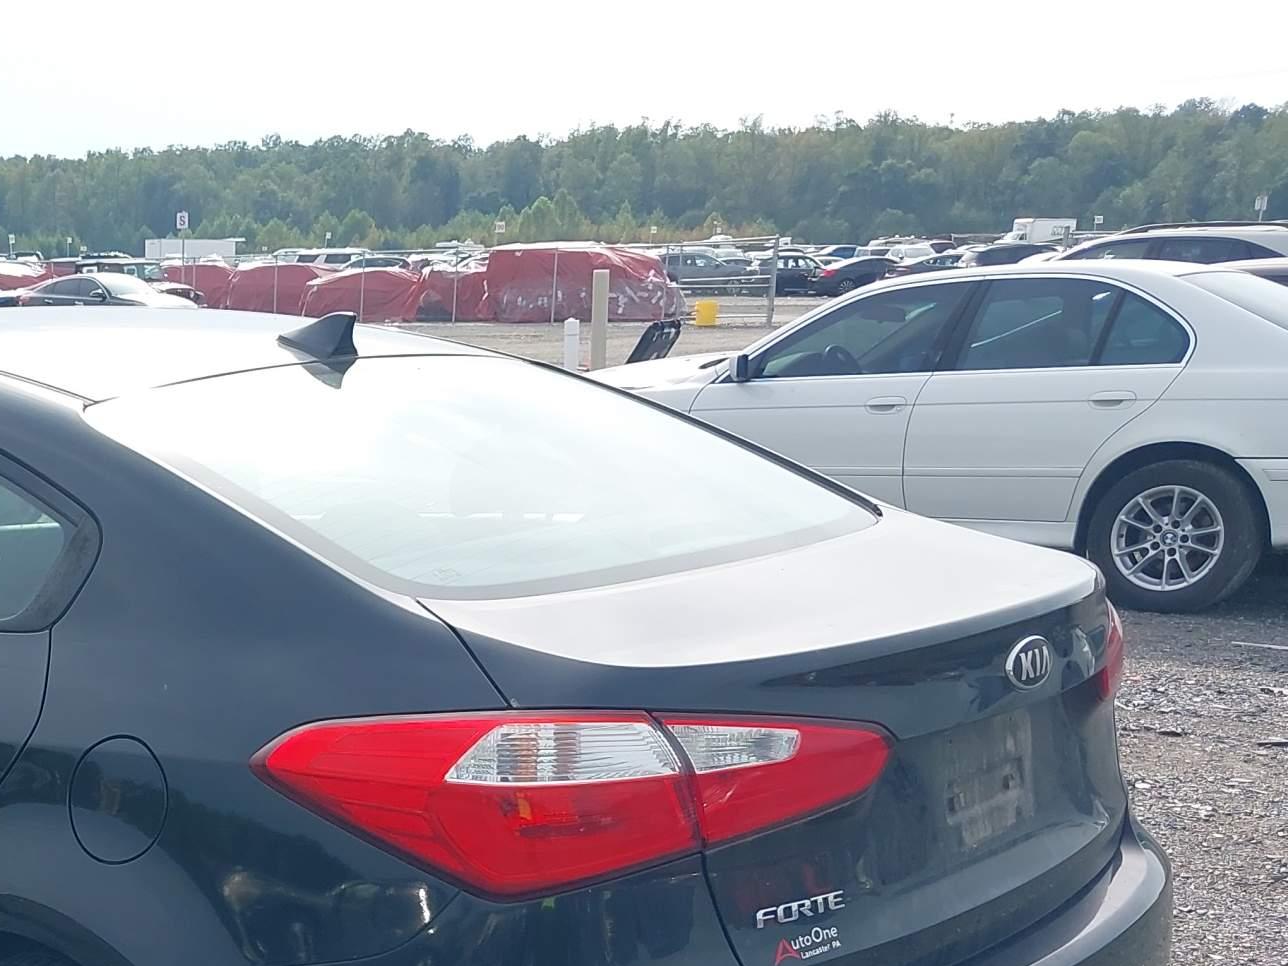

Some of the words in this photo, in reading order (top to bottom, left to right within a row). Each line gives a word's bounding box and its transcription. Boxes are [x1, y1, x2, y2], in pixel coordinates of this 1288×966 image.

[1019, 645, 1050, 680] KIA
[756, 890, 846, 929] FORTE
[774, 927, 838, 966] AutoOne
[801, 944, 830, 959] Lancaster
